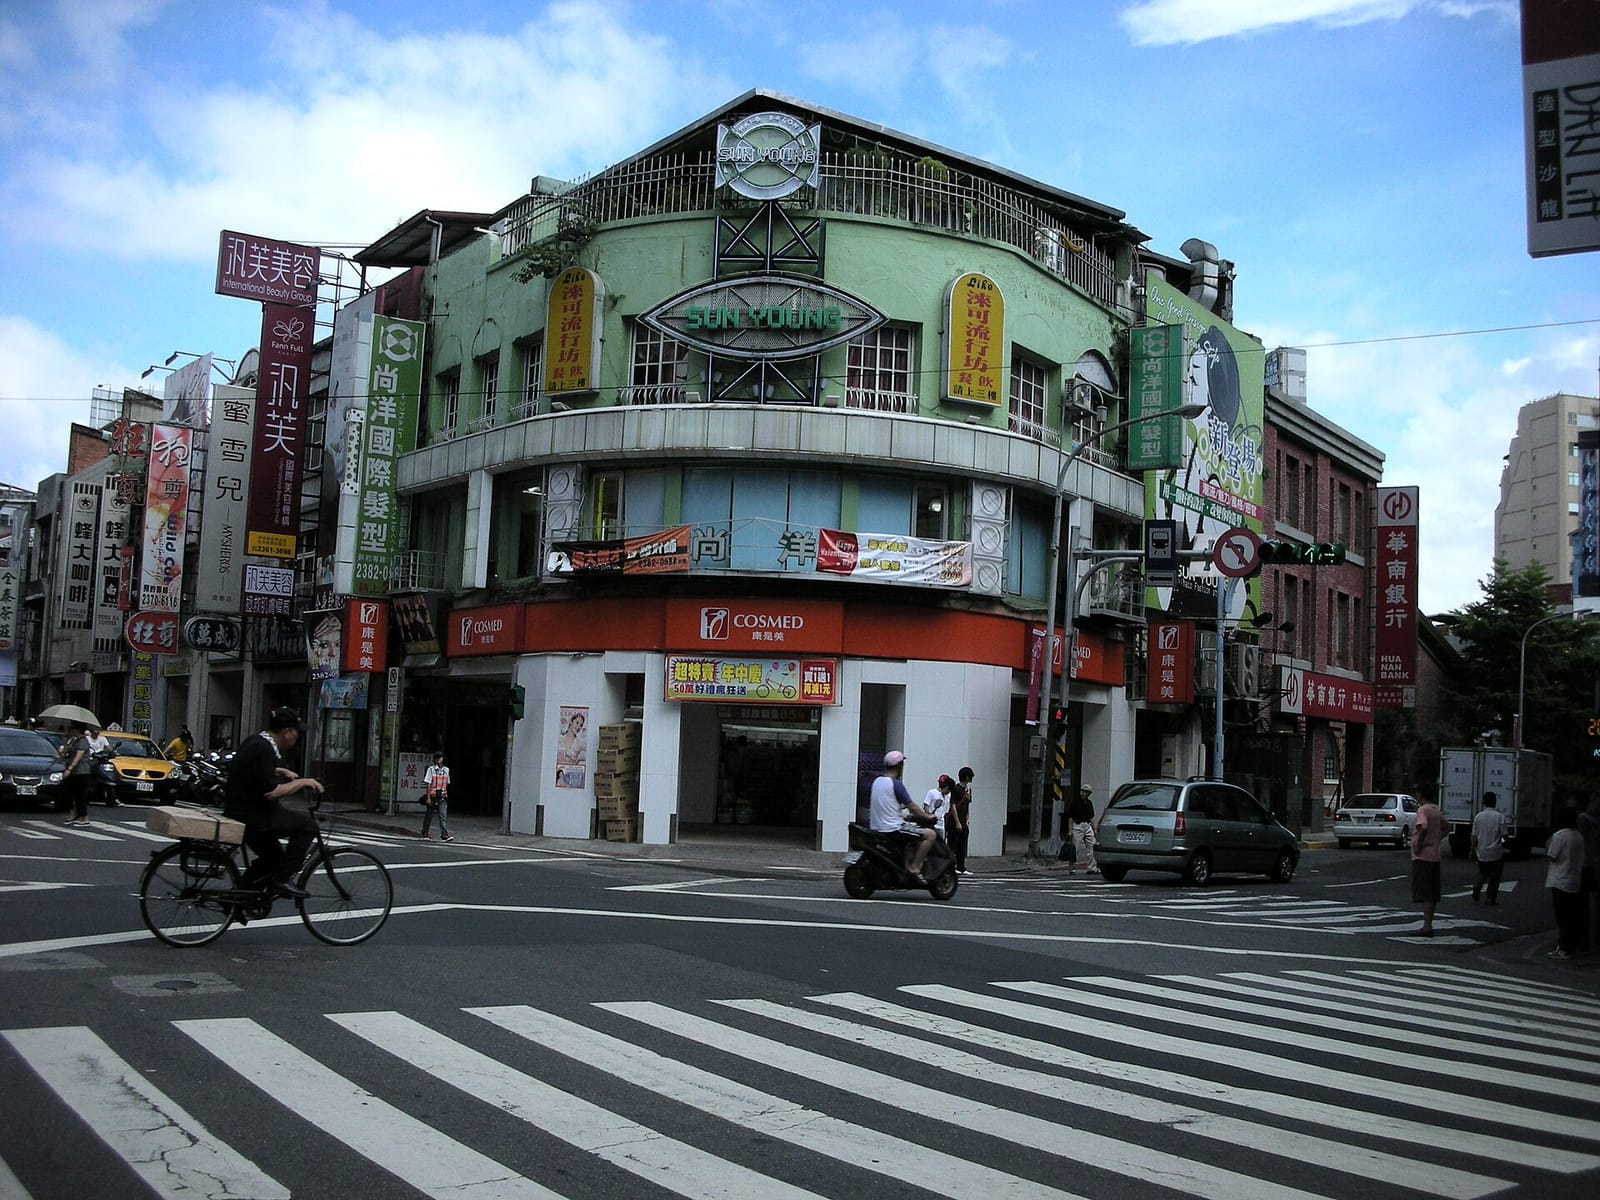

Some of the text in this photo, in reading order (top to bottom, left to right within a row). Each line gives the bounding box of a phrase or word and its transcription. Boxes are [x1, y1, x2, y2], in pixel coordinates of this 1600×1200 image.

[718, 147, 816, 163] SUN YOUNG
[1536, 95, 1559, 218] 造型沙龍
[222, 278, 313, 302] International Beauty Group
[684, 305, 842, 330] SUN YOUNG
[953, 384, 997, 401] 請上三樓
[1140, 359, 1162, 458] 尚洋國際髮型
[361, 363, 399, 553] 尚洋國際髮型
[1209, 414, 1257, 482] 新登場
[692, 526, 817, 567] 尚 洋
[69, 522, 93, 603] 蜂大咖啡
[1384, 530, 1409, 630] 華南銀行
[474, 618, 503, 634] COSMED
[733, 614, 804, 629] COSMED
[359, 626, 376, 670] 康是美
[751, 631, 785, 642] 康是美
[1380, 655, 1402, 663] HUA
[1380, 663, 1402, 671] NAN
[721, 663, 764, 684] 年中慶
[1160, 654, 1176, 699] 康是美
[1380, 671, 1409, 680] BANK
[1306, 679, 1346, 714] 華南銀行
[1587, 717, 1600, 736] 2
